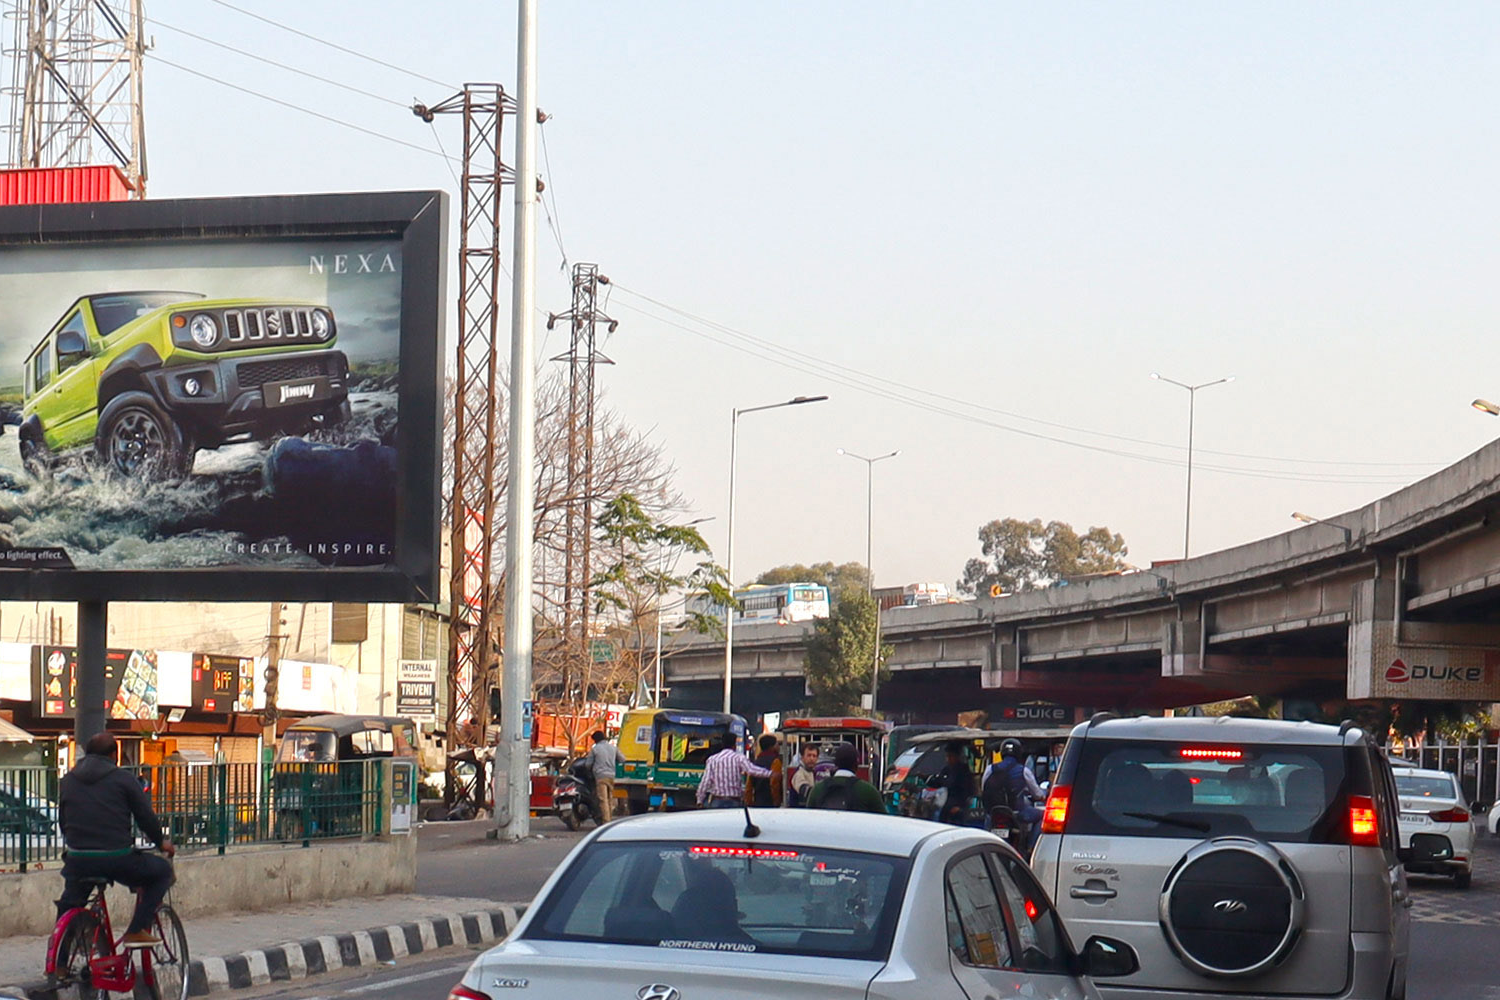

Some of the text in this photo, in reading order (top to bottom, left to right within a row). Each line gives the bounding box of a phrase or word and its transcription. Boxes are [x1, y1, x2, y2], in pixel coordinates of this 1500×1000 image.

[308, 253, 397, 275] NEXA
[279, 383, 316, 403] Jimny
[225, 543, 392, 555] CREATE. INSPIRE.
[6, 551, 37, 562] lighting
[38, 551, 63, 560] effect.
[1411, 664, 1481, 682] DUKE
[400, 683, 433, 696] TRIVENI
[1016, 708, 1065, 719] DUKE
[659, 940, 717, 951] NORTHERN
